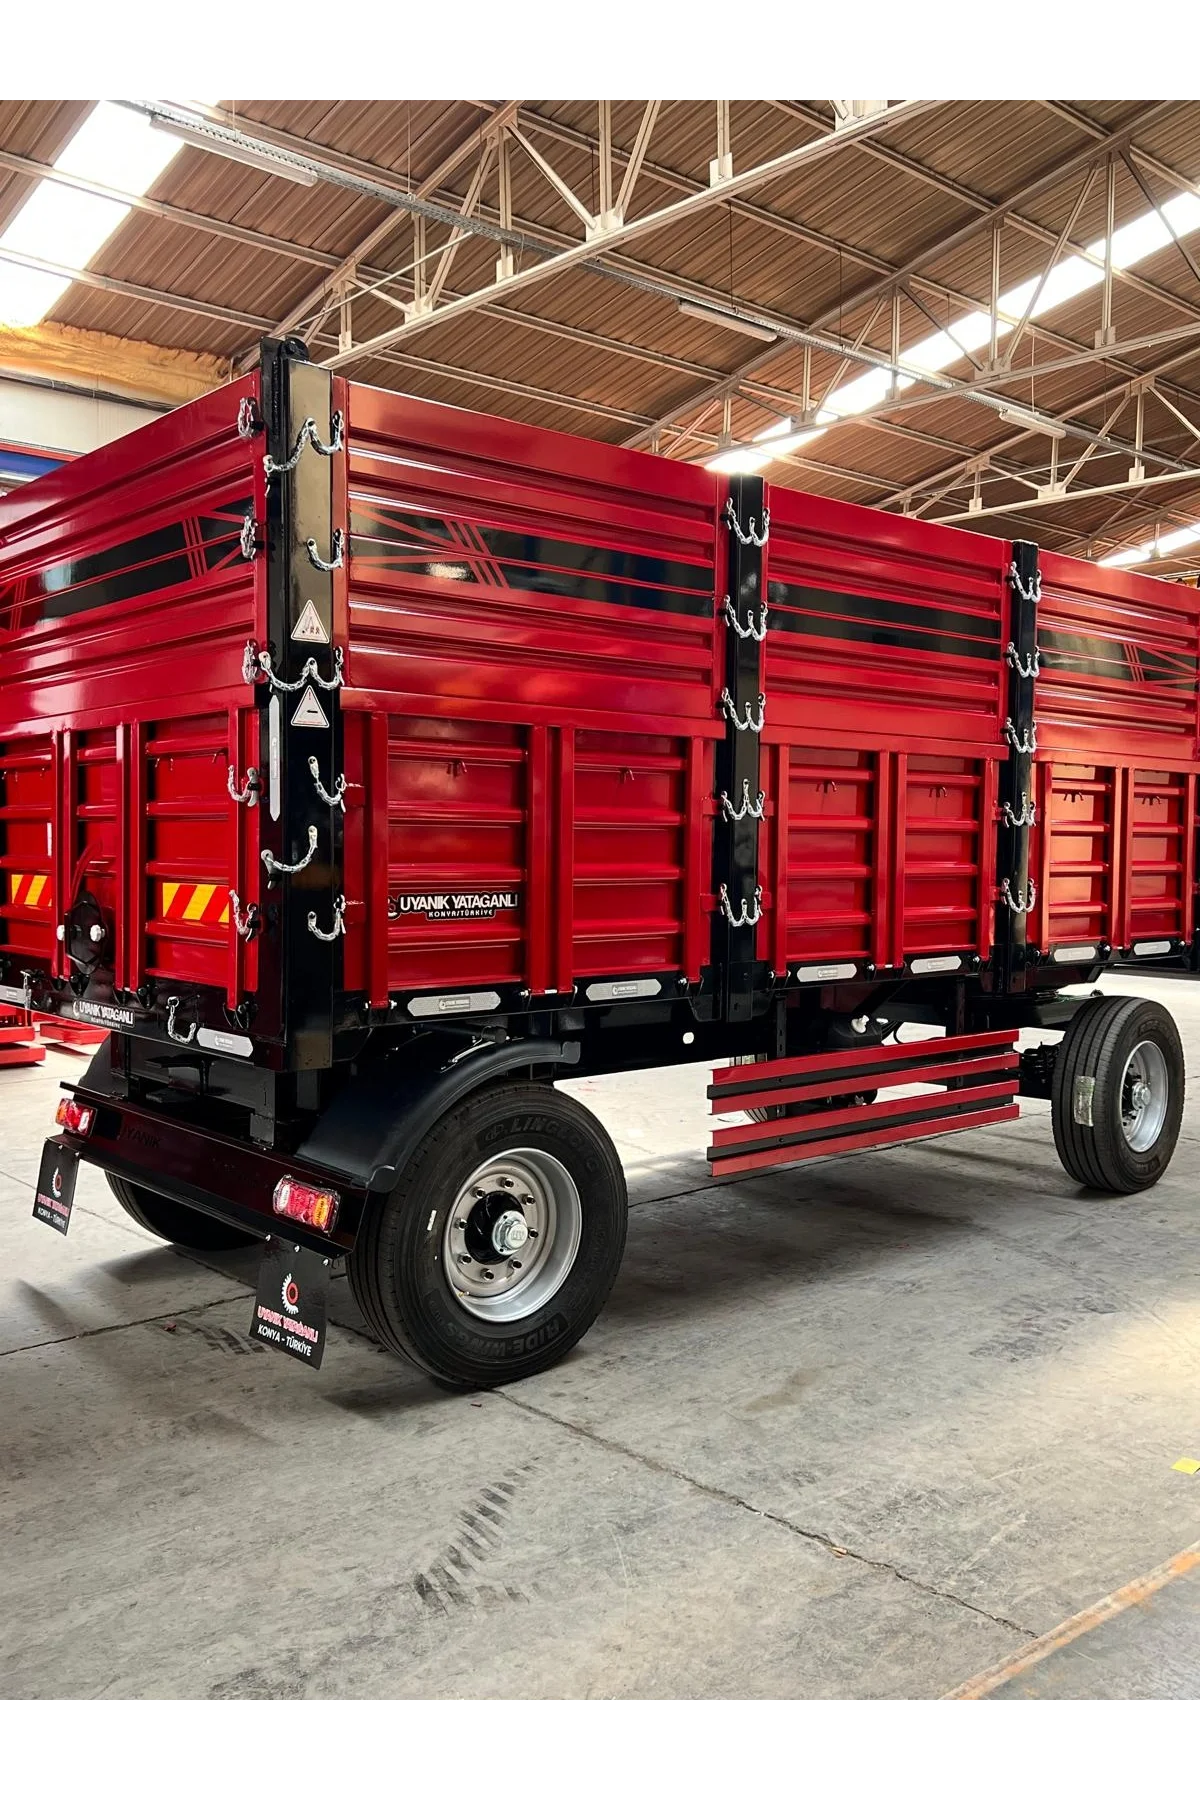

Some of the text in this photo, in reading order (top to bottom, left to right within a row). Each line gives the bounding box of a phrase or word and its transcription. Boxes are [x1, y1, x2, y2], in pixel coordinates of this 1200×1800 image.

[400, 895, 450, 911] UYANIK
[257, 1324, 281, 1343] KONYA
[286, 1336, 312, 1357] TÜRKİYE
